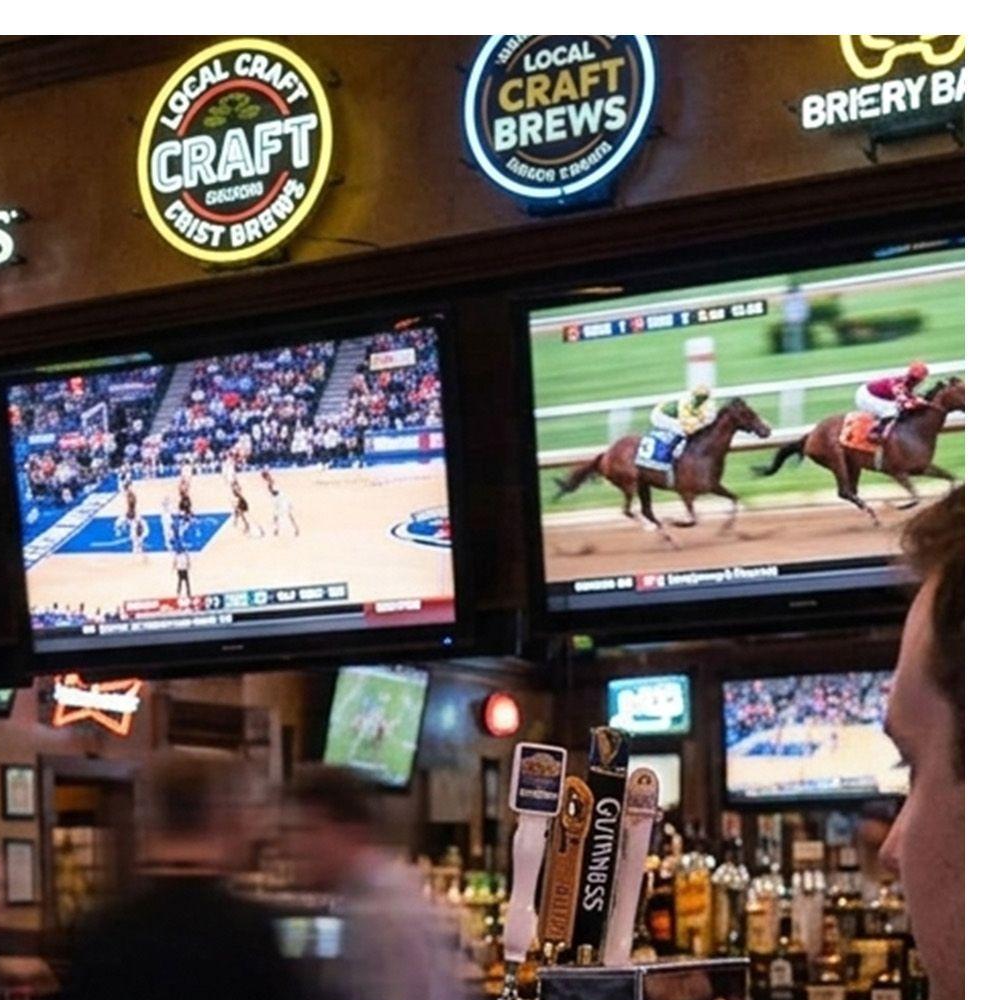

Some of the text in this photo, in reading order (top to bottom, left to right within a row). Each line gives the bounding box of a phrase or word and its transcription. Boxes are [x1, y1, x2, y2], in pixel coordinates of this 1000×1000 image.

[498, 57, 625, 112] CRAFT
[523, 41, 596, 72] LOCAL
[160, 53, 309, 131] LOCAL CRAFT
[494, 95, 627, 152] BREWS
[151, 113, 318, 193] CRAFT
